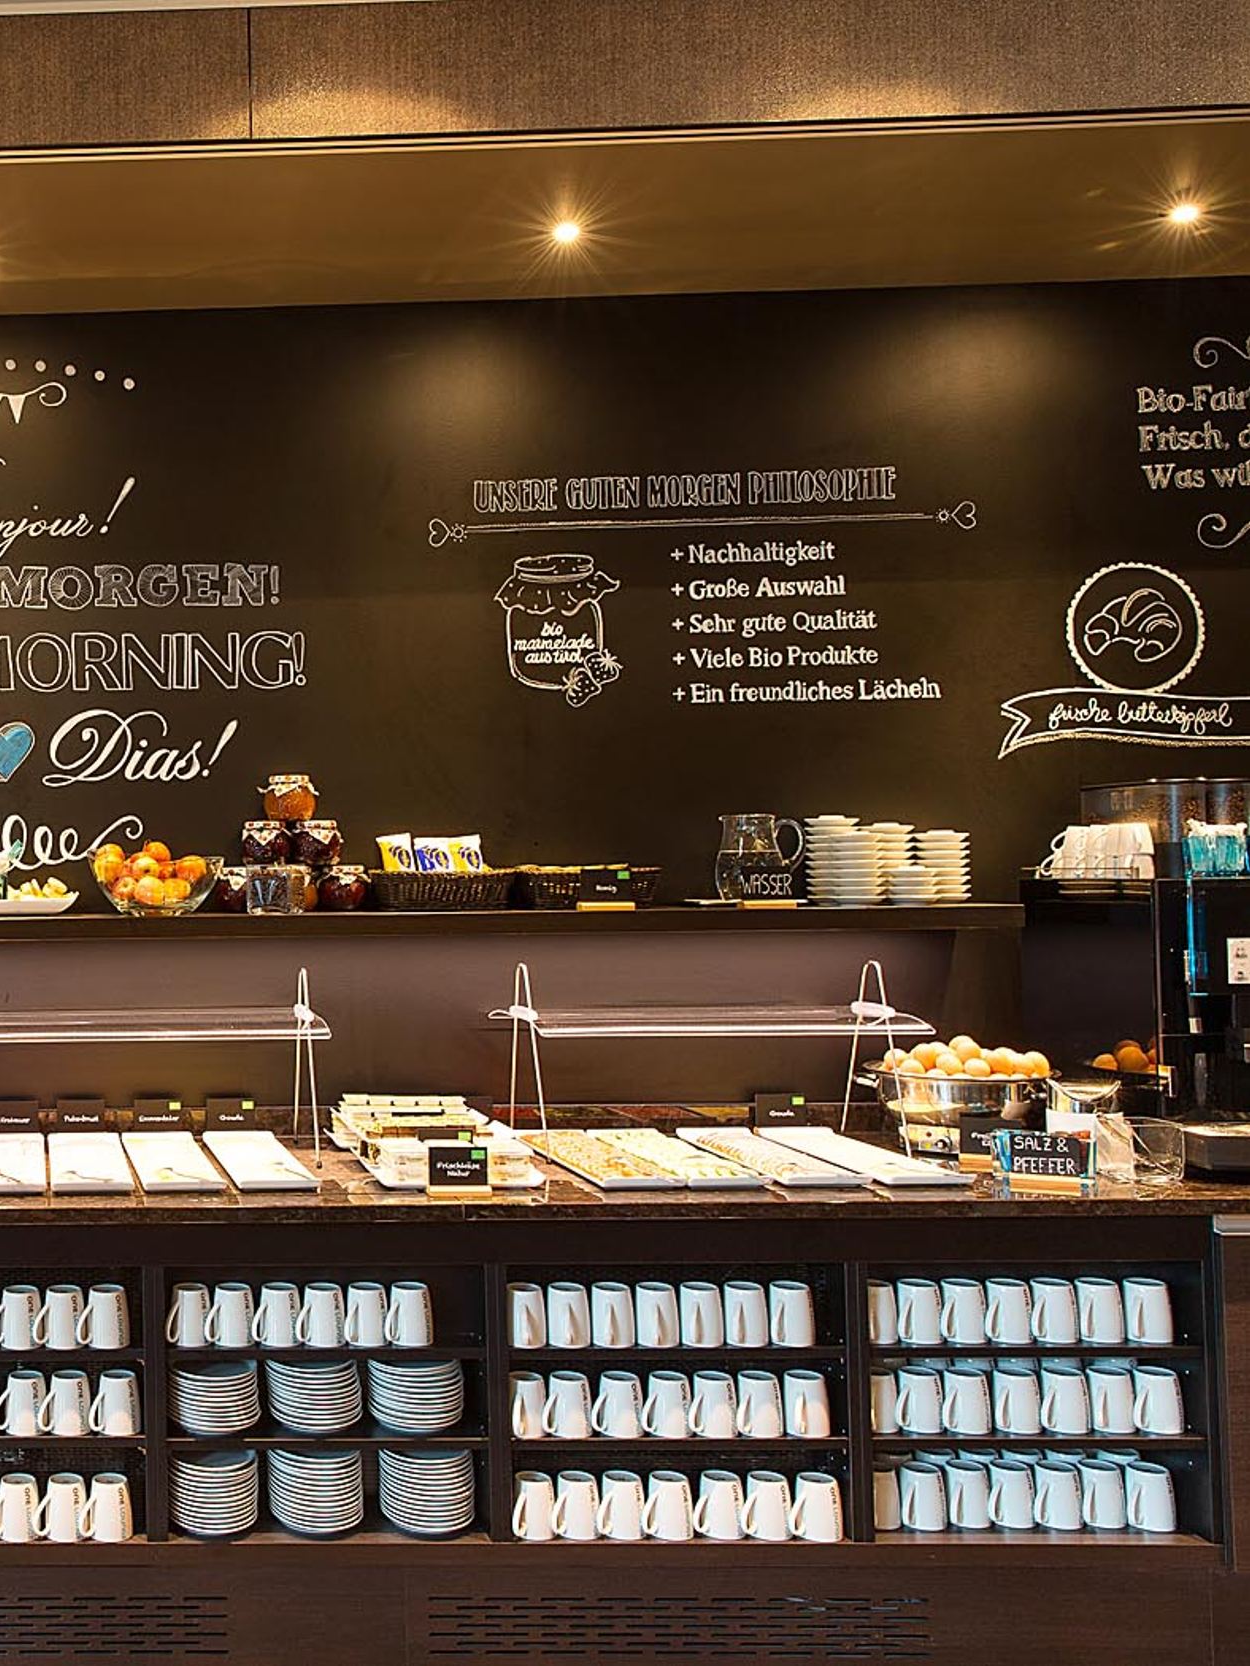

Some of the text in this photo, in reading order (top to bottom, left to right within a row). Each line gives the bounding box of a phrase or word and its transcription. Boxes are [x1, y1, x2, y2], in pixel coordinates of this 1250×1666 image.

[473, 466, 897, 513] UNSERE GUTEN MORGEN PHILOSOPHIE
[1141, 463, 1206, 490] Was
[688, 540, 835, 567] Nachhaltigkeit
[688, 577, 750, 600] Große
[754, 574, 847, 598] Auswahl
[689, 613, 736, 634] Sehr
[741, 613, 787, 638] gute
[792, 608, 878, 634] Qualität
[689, 646, 744, 669] Viele
[748, 646, 783, 667] Bio
[786, 644, 879, 666] Produkte
[689, 683, 725, 704] Ein
[729, 680, 854, 702] freundliches
[858, 676, 942, 700] Lächeln
[41, 709, 238, 788] Dias!
[741, 873, 792, 896] WASSER
[1013, 1135, 1069, 1151] SALZ &
[1013, 1157, 1077, 1175] PFEFFER
